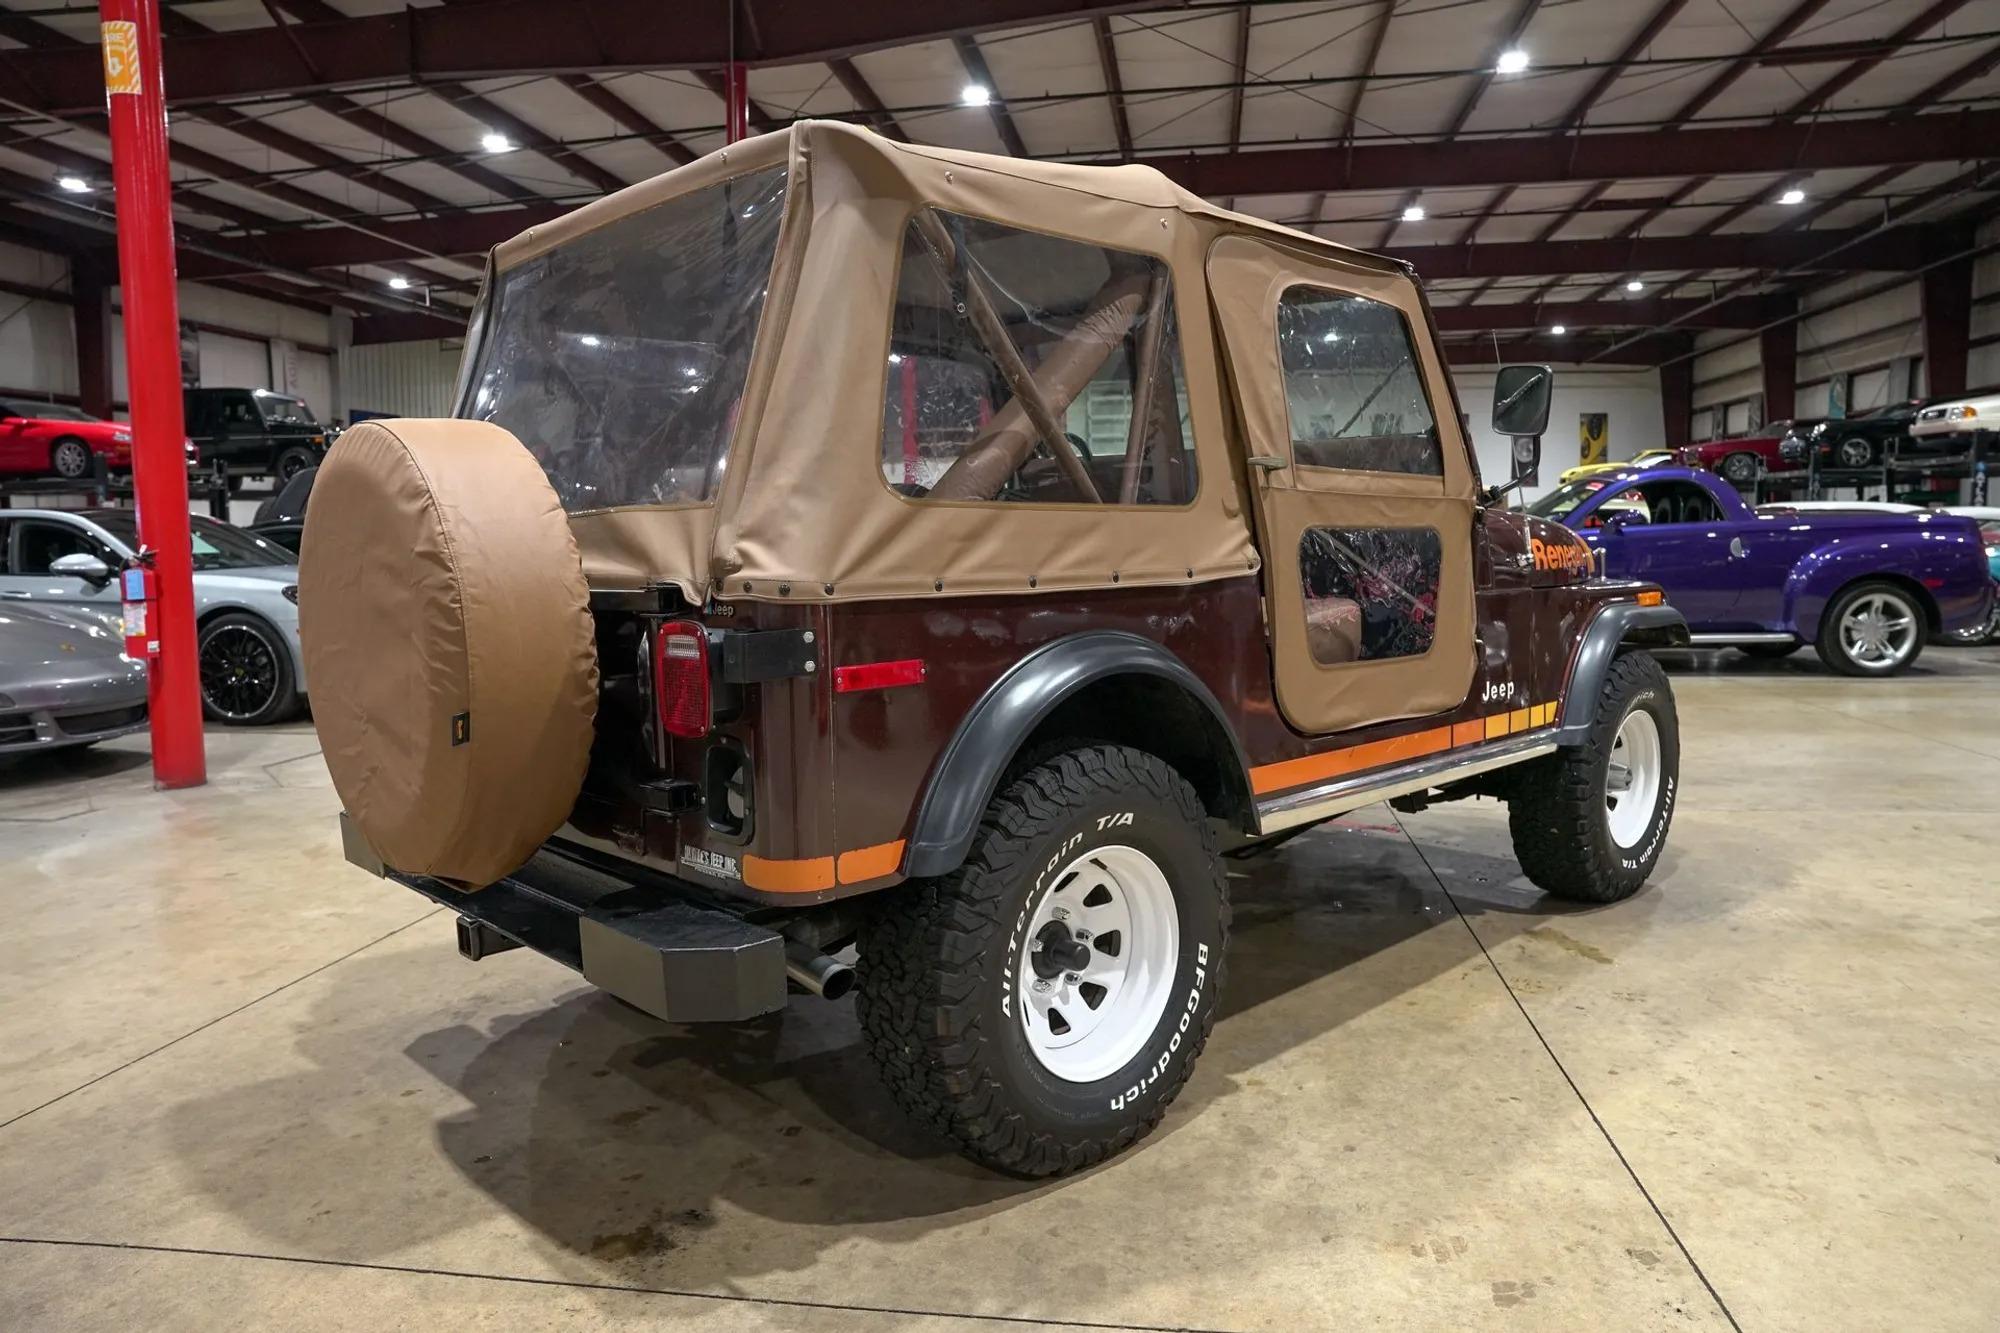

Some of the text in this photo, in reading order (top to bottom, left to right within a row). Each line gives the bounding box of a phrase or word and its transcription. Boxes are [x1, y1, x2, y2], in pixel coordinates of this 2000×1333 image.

[1482, 681, 1515, 701] Jeep
[1621, 776, 1674, 869] All-Terrain T/A
[1002, 812, 1134, 1018] All-Terrain T/A
[1110, 942, 1209, 1111] BFGoodrich
